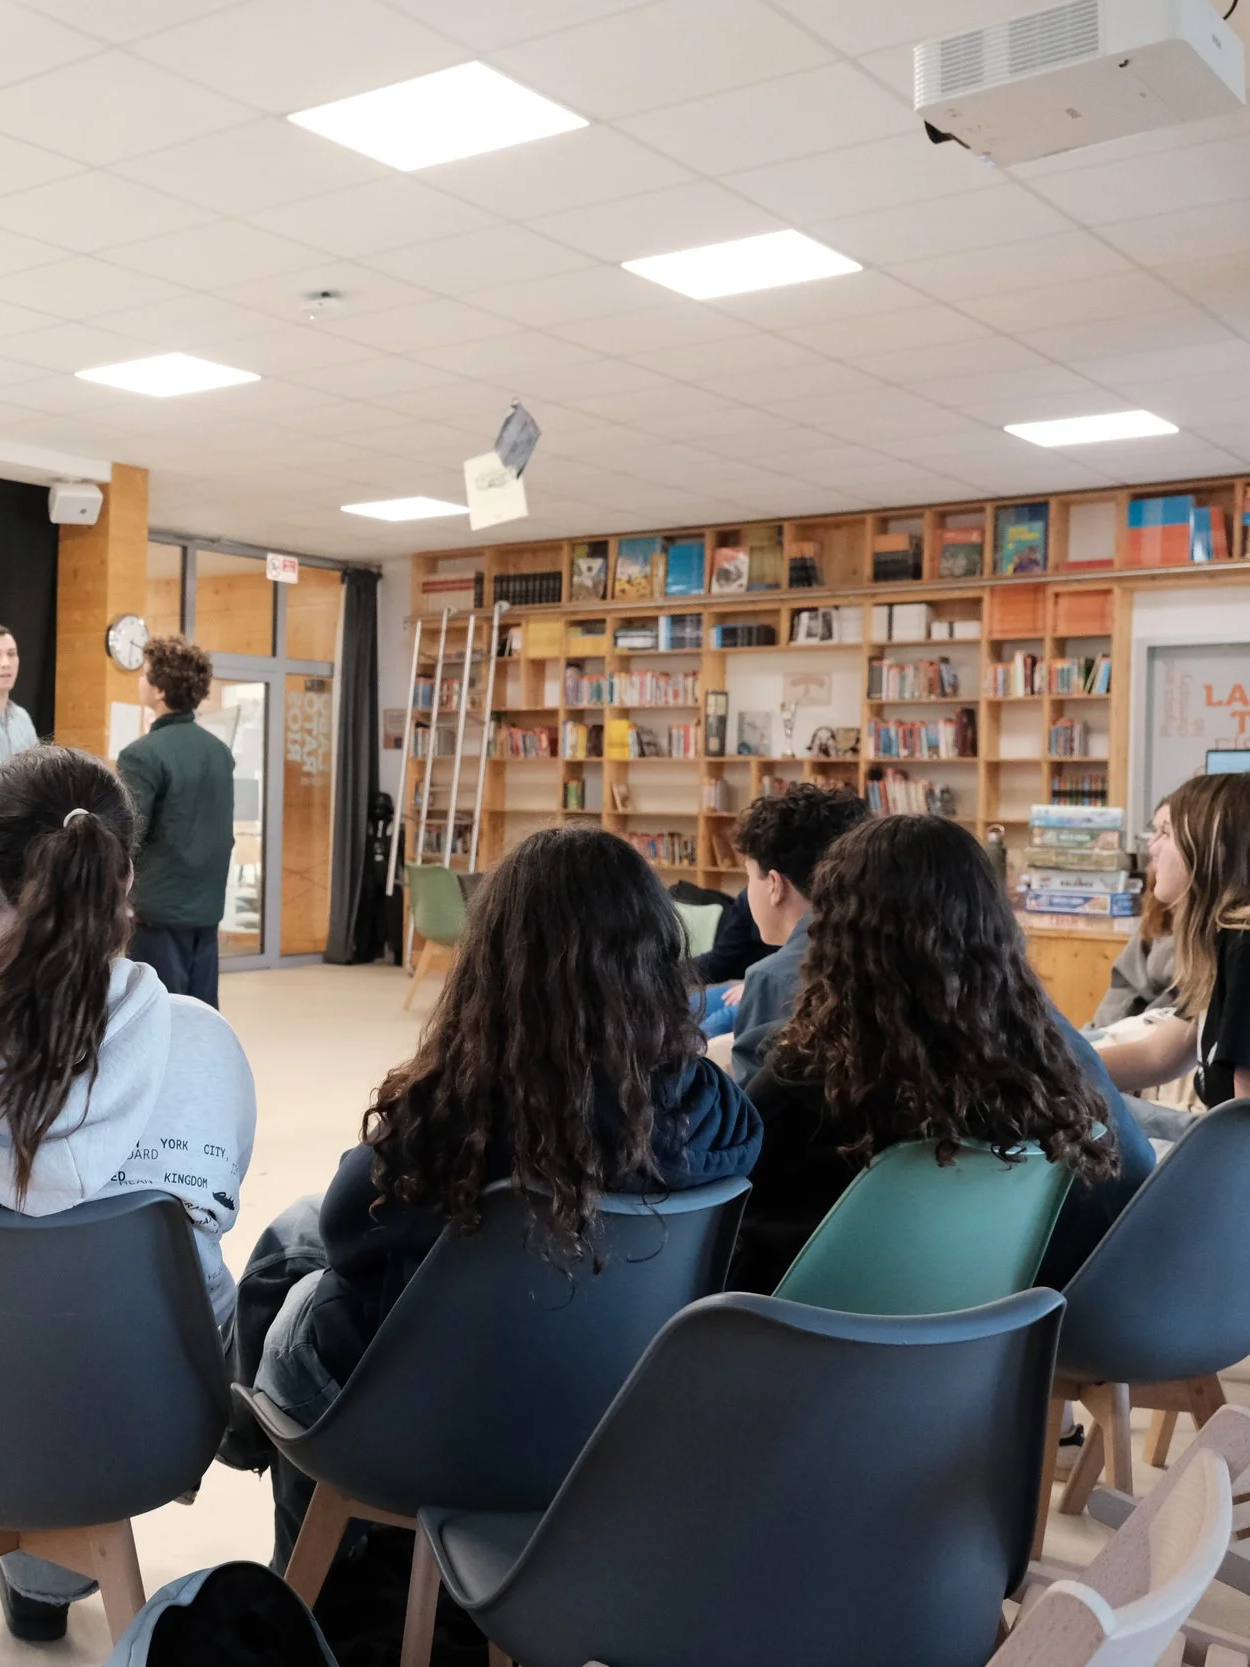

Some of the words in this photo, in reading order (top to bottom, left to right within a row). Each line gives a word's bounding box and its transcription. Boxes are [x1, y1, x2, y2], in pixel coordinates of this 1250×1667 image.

[160, 1138, 189, 1151] YORK
[203, 1144, 230, 1161] CITY,
[163, 1172, 208, 1189] KINGDOM
